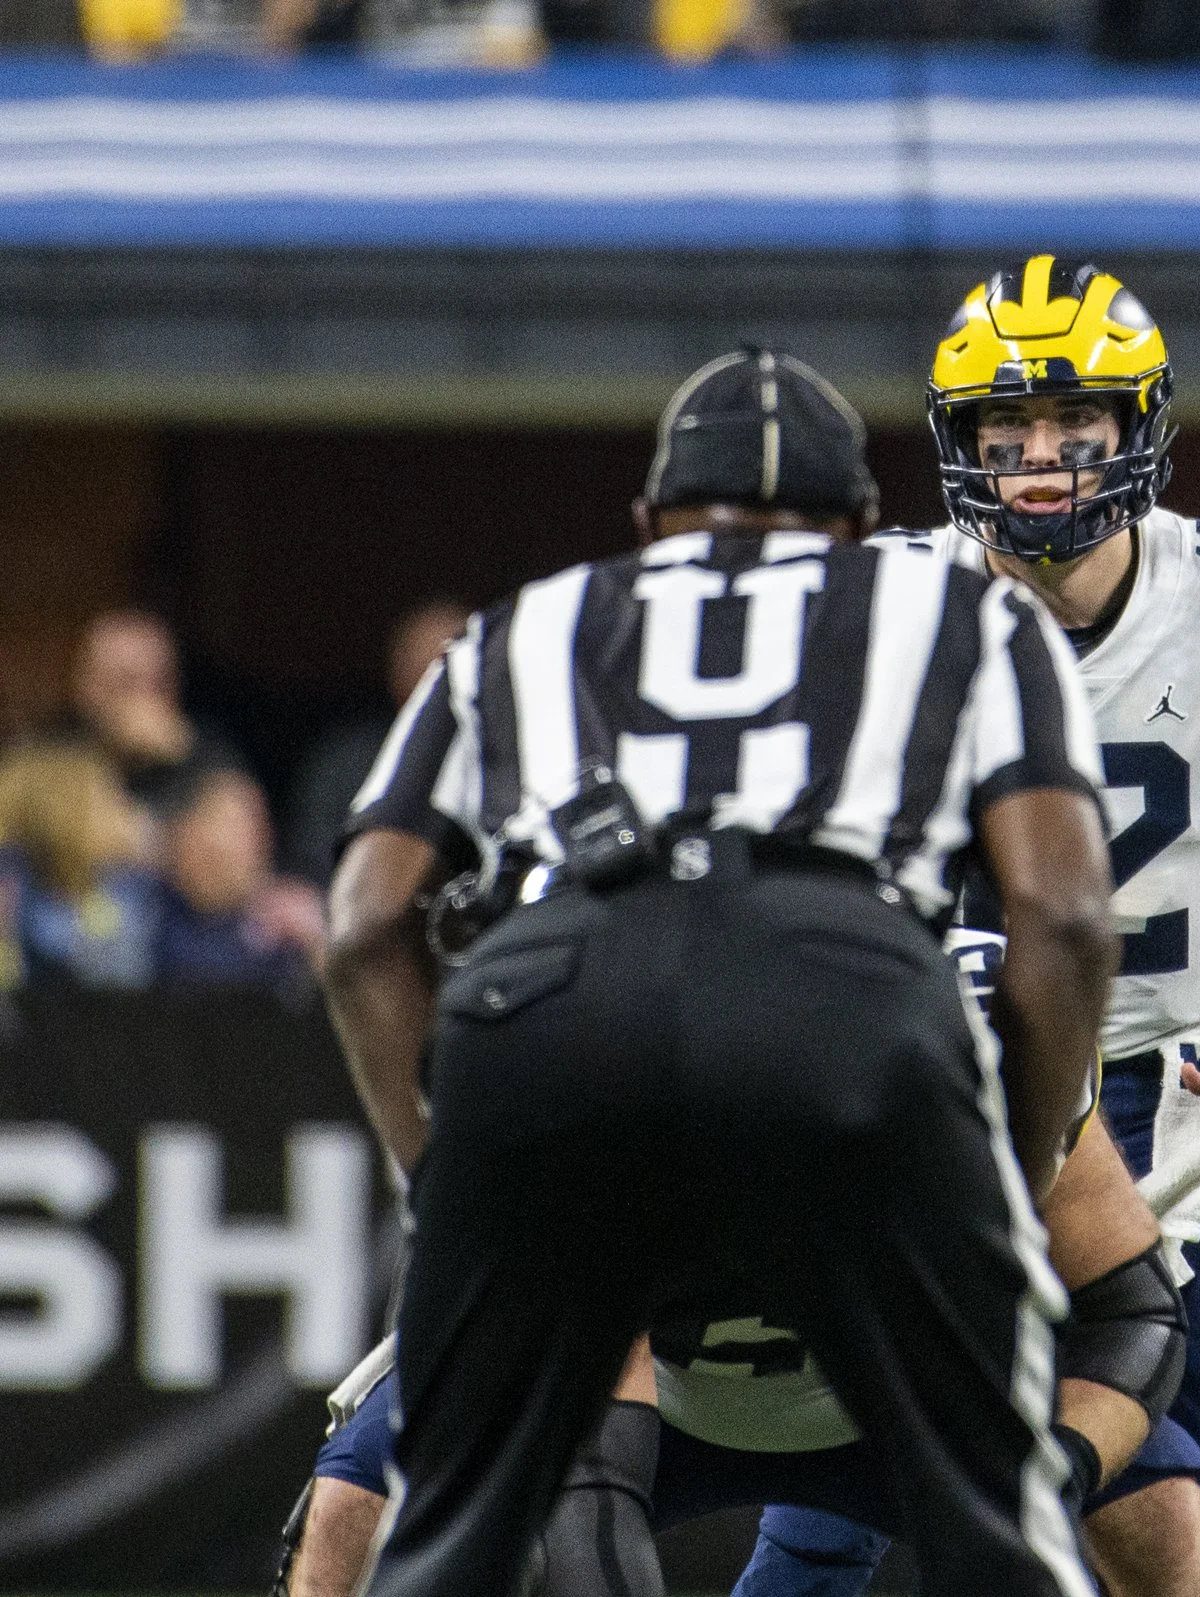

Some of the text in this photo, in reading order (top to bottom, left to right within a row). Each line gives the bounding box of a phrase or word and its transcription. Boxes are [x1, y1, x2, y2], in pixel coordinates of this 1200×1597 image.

[1021, 358, 1048, 379] M
[632, 560, 827, 722] U
[1097, 741, 1192, 976] 2
